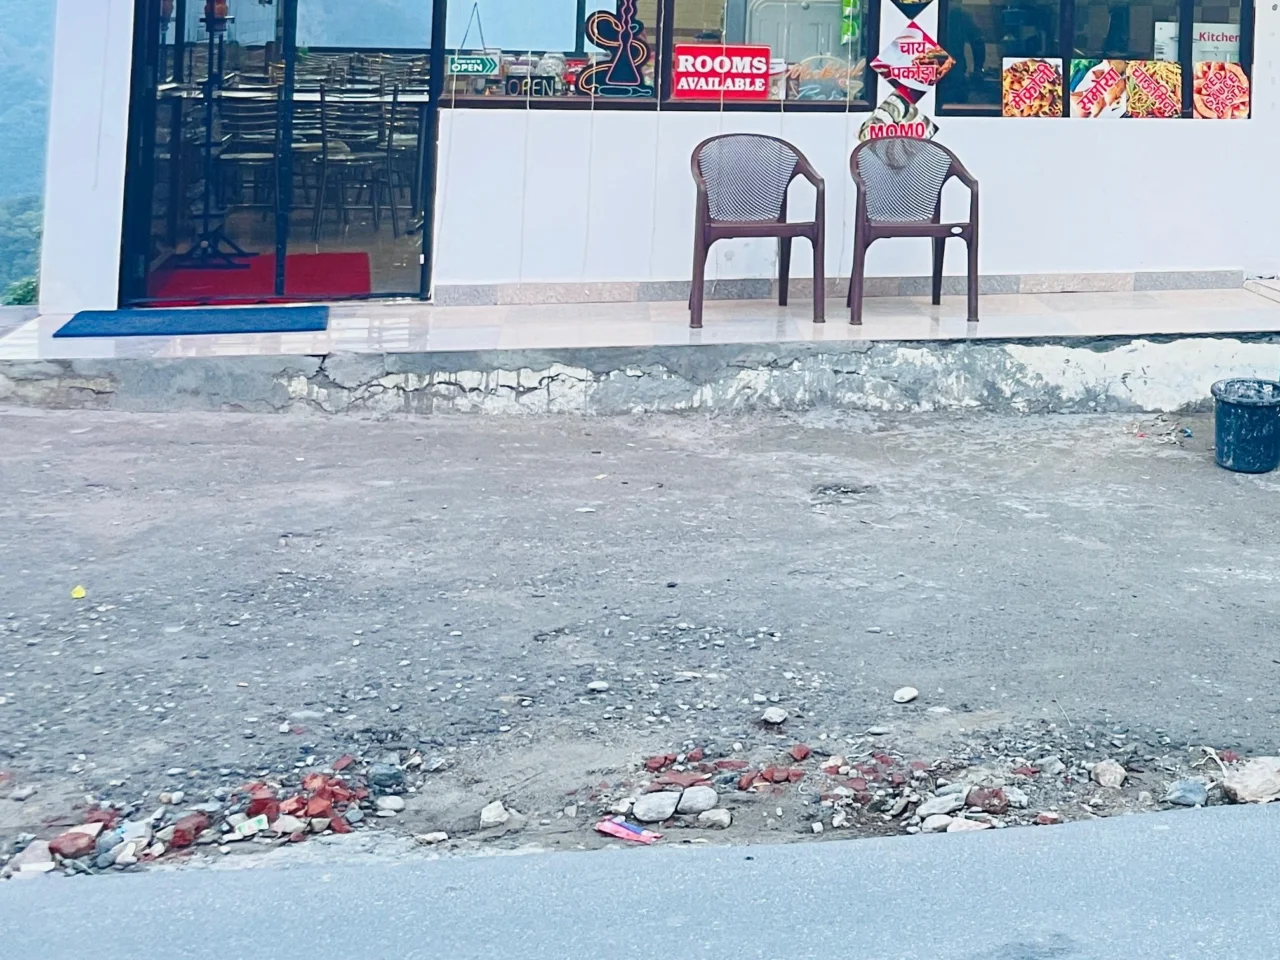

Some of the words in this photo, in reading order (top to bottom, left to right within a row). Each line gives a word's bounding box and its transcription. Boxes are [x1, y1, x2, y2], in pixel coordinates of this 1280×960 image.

[899, 41, 926, 55] चाय
[451, 63, 483, 72] OPEN
[677, 55, 768, 74] ROOMS
[508, 78, 554, 97] OPEN
[677, 77, 766, 91] AVAILABLE
[1077, 67, 1122, 111] समोसा
[1202, 71, 1223, 93] RED
[1205, 73, 1238, 107] SAUCE
[1213, 84, 1245, 116] PASTA
[869, 122, 926, 140] MOMO
